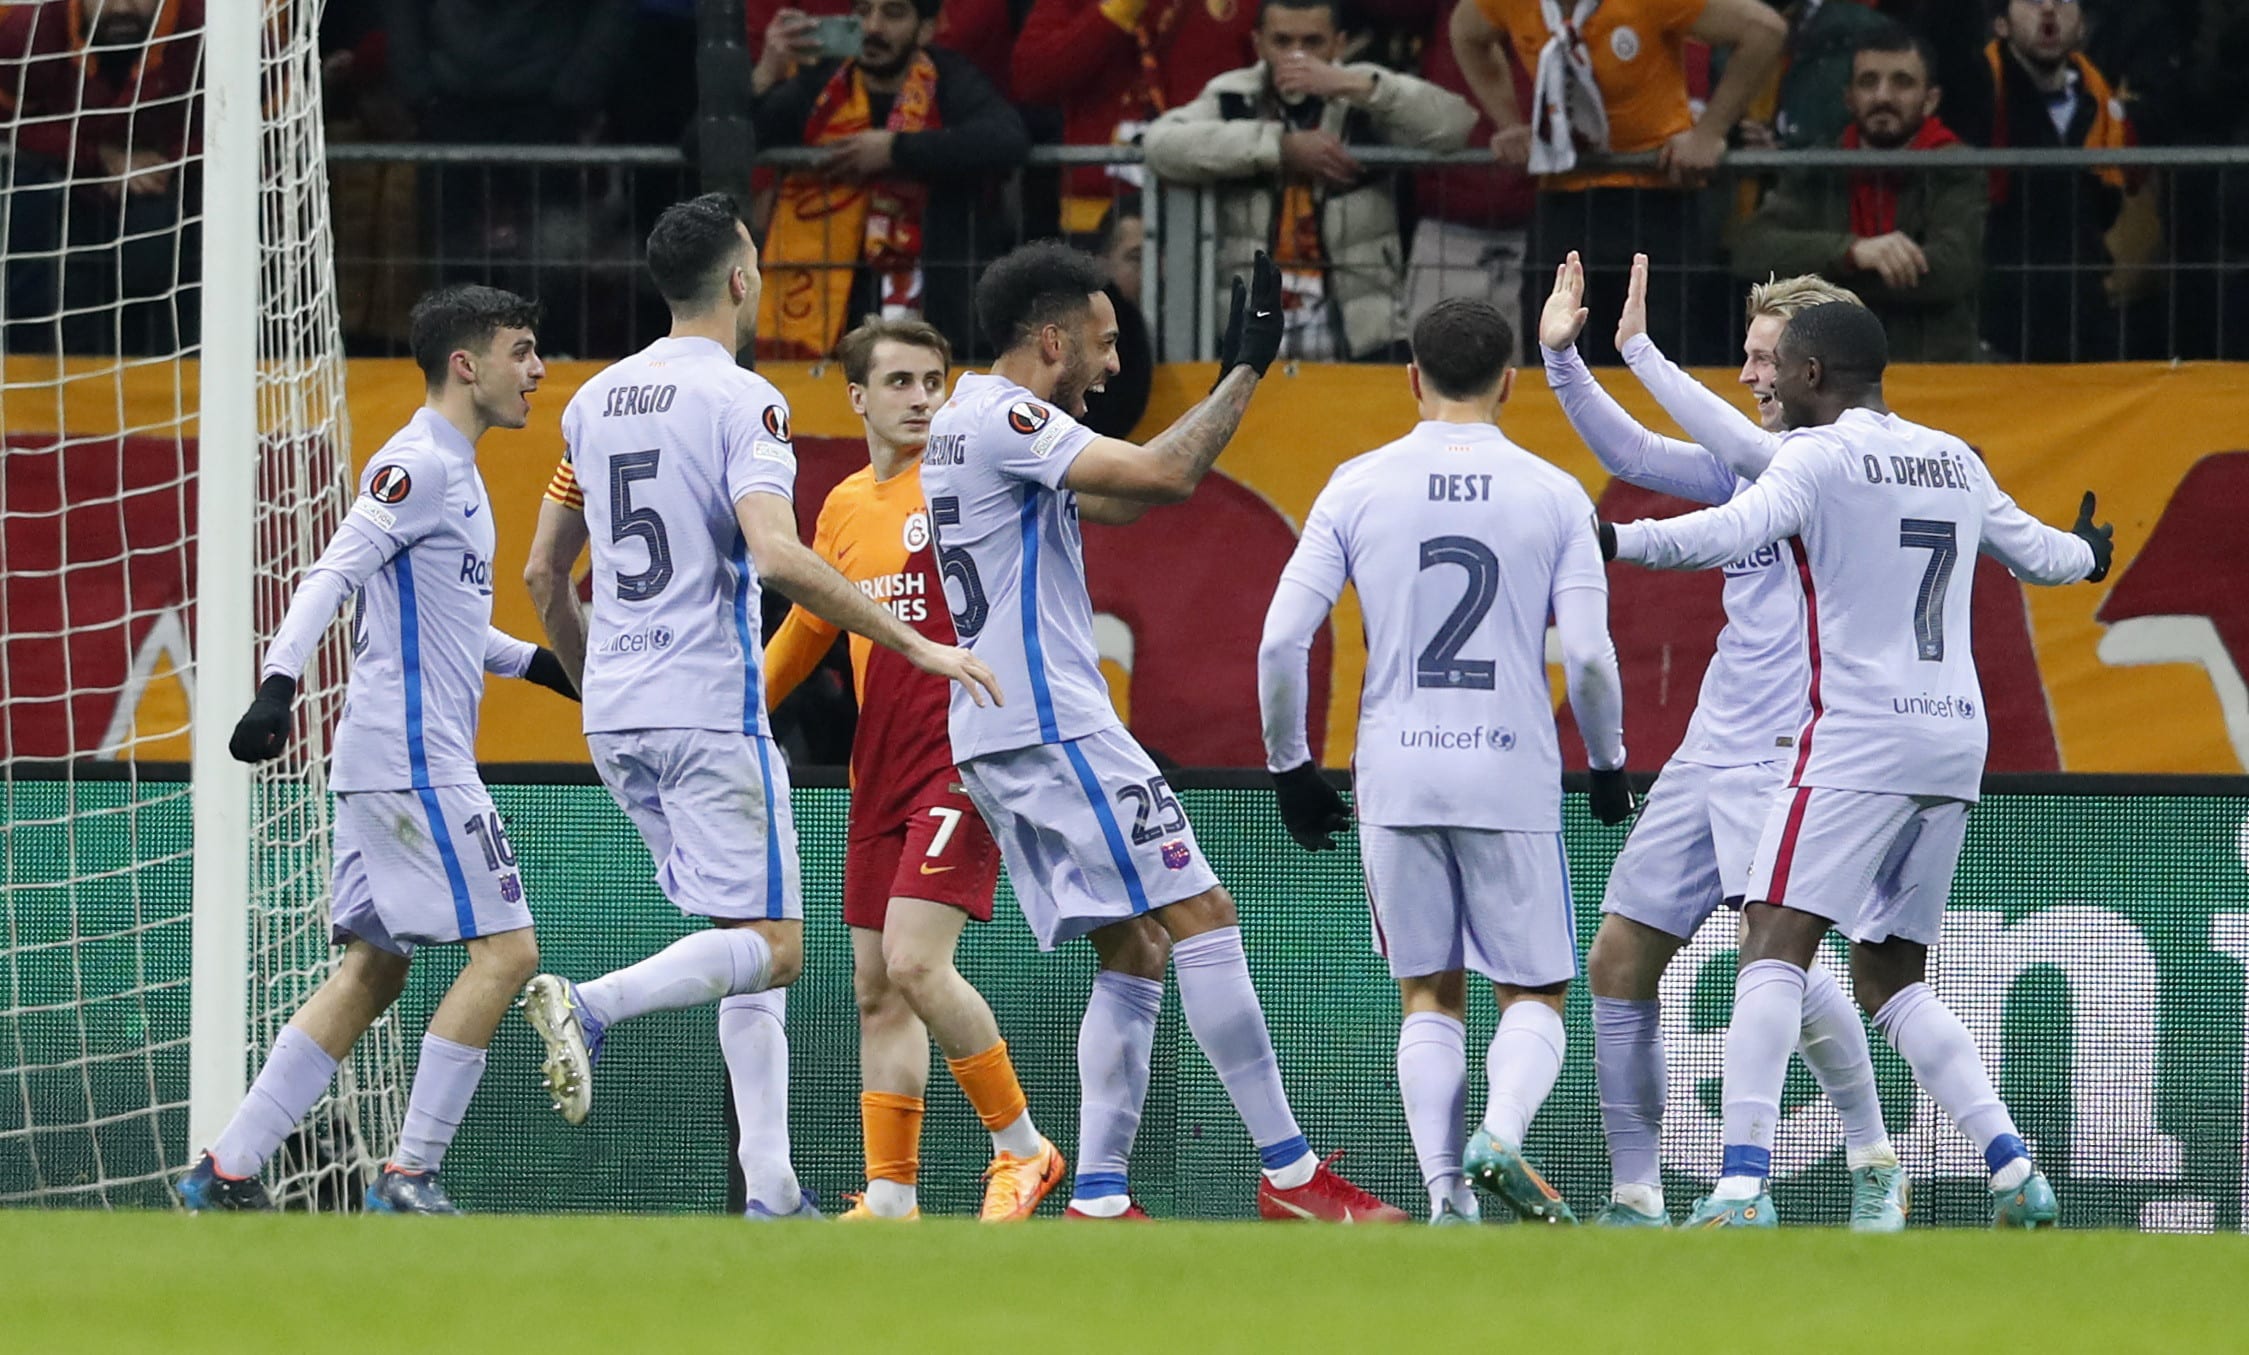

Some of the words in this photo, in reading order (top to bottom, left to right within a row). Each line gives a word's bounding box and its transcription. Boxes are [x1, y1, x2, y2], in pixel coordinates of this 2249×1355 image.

[603, 384, 677, 418] SERGIO
[1428, 473, 1493, 501] DEST
[609, 449, 674, 602] 5
[1417, 535, 1499, 690] 2
[1900, 518, 1958, 662] 7
[1893, 692, 1954, 718] unicef
[1400, 726, 1484, 750] unicef
[925, 806, 962, 858] 7
[1116, 775, 1186, 846] 25
[464, 812, 516, 872] 16
